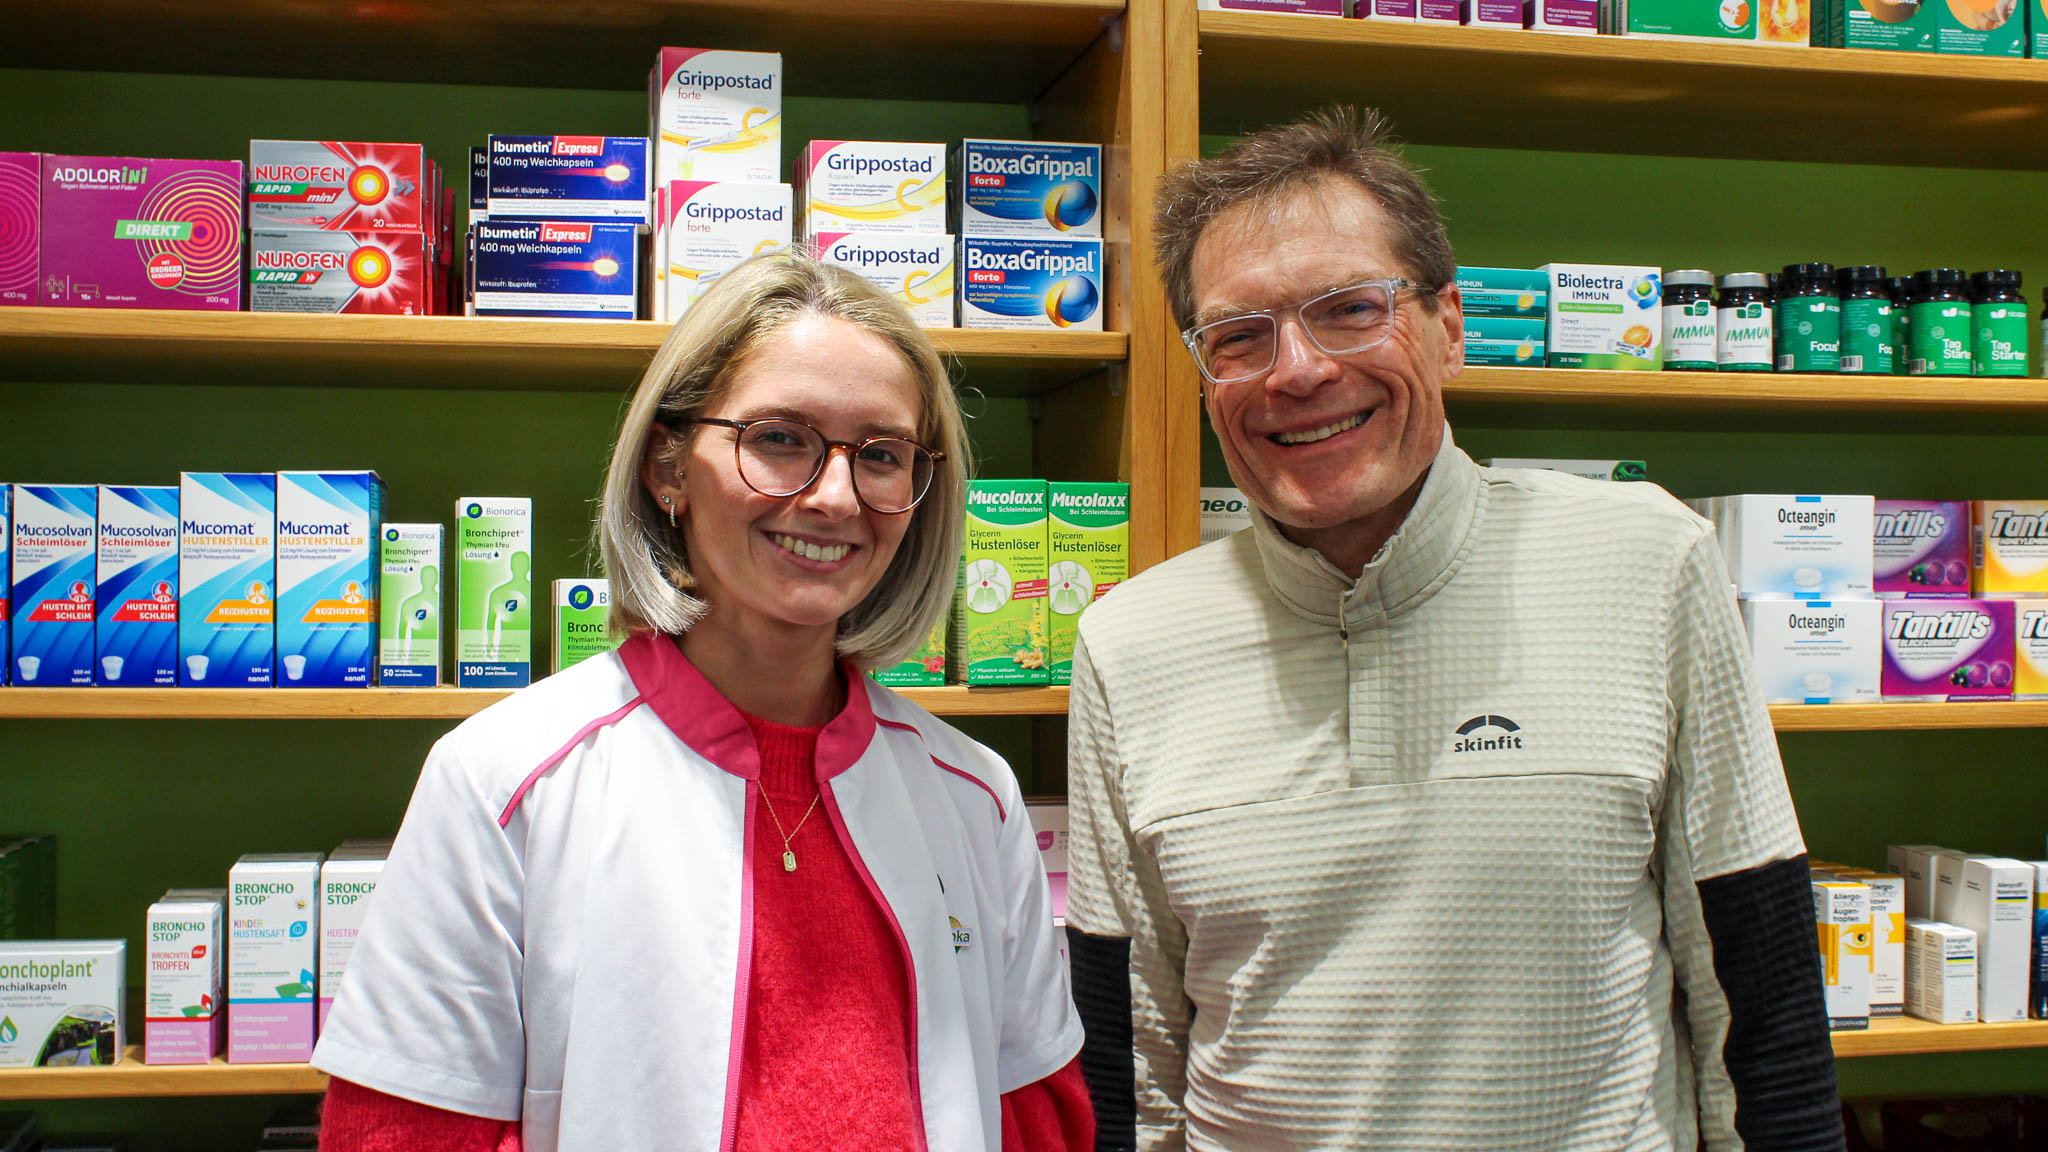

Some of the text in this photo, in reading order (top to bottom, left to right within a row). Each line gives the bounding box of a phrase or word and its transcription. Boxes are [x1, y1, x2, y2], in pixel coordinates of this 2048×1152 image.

[677, 70, 772, 90] Grippostad
[678, 88, 702, 100] forte
[494, 141, 598, 156] Ibumetin Express
[493, 157, 512, 166] 400
[513, 160, 528, 168] mg
[530, 157, 594, 168] Weichkapseln
[828, 154, 932, 175] Grippostad
[969, 152, 1093, 182] BoxaGrippal
[255, 166, 345, 182] NUROFEN
[474, 168, 488, 176] 40
[974, 176, 1000, 185] forte
[254, 184, 292, 193] RAPID
[306, 193, 337, 203] mini
[686, 202, 782, 222] Grippostad
[373, 219, 384, 228] 20
[688, 220, 711, 232] forte
[126, 223, 181, 237] DIREKT
[480, 227, 586, 242] Ibumetin Express
[480, 243, 582, 254] 400 mg Weichkapseln
[256, 252, 345, 269] NUROFEN
[834, 245, 940, 266] Grippostad
[968, 248, 1094, 276] BoxaGrippal
[256, 272, 298, 282] RAPID
[974, 272, 1000, 282] forte
[1558, 272, 1624, 290] Biolectra
[1456, 280, 1484, 288] IMMUN
[1572, 291, 1610, 300] IMMUN
[1672, 324, 1715, 340] IMMUN
[1726, 327, 1770, 342] IMMUN
[1942, 338, 1961, 350] Tag
[1990, 340, 2012, 352] Tag
[968, 490, 1044, 505] Mucolaxx
[1052, 492, 1126, 508] Mucolaxx
[486, 508, 526, 516] Bionorica
[1778, 508, 1836, 526] Octeangin
[16, 524, 92, 536] Mucosolvan
[100, 524, 176, 537] Mucosolvan
[182, 520, 254, 535] Mucomat
[280, 521, 350, 535] Mucomat
[402, 532, 434, 540] Bionorica
[466, 529, 520, 539] Bronchipret
[970, 530, 1001, 538] Glycerin
[1052, 532, 1084, 540] Glycerin
[16, 538, 88, 546] Schleimlöser
[101, 538, 172, 547] Schleimlöser
[183, 537, 268, 546] HUSTENSTILLER
[280, 537, 364, 546] HUSTENSTILLER
[971, 538, 1040, 550] Hustenlöser
[1054, 541, 1122, 552] Hustenlöser
[385, 548, 428, 556] Bronchipret
[466, 552, 492, 560] Lösung
[126, 603, 176, 611] HUSTEN MIT
[219, 608, 270, 616] REIZHUSTEN
[315, 608, 366, 616] REIZHUSTEN
[1789, 614, 1845, 632] Octeangin
[1890, 611, 1992, 640] Tantills
[383, 669, 394, 677] 50
[464, 666, 484, 676] 100
[1454, 736, 1522, 752] skinfit
[235, 883, 294, 894] BRONCHO
[327, 882, 376, 894] BRONCH
[235, 896, 266, 906] STOP
[327, 894, 358, 905] STOP
[152, 922, 206, 932] BRONCHO
[234, 920, 264, 928] KINDER
[152, 932, 180, 942] STOP
[234, 929, 286, 938] HUSTENSAFT
[327, 928, 358, 937] HUSTEN
[152, 952, 190, 960] BRONCHITIS
[152, 960, 190, 970] TROPFEN
[0, 960, 92, 982] onchoplant
